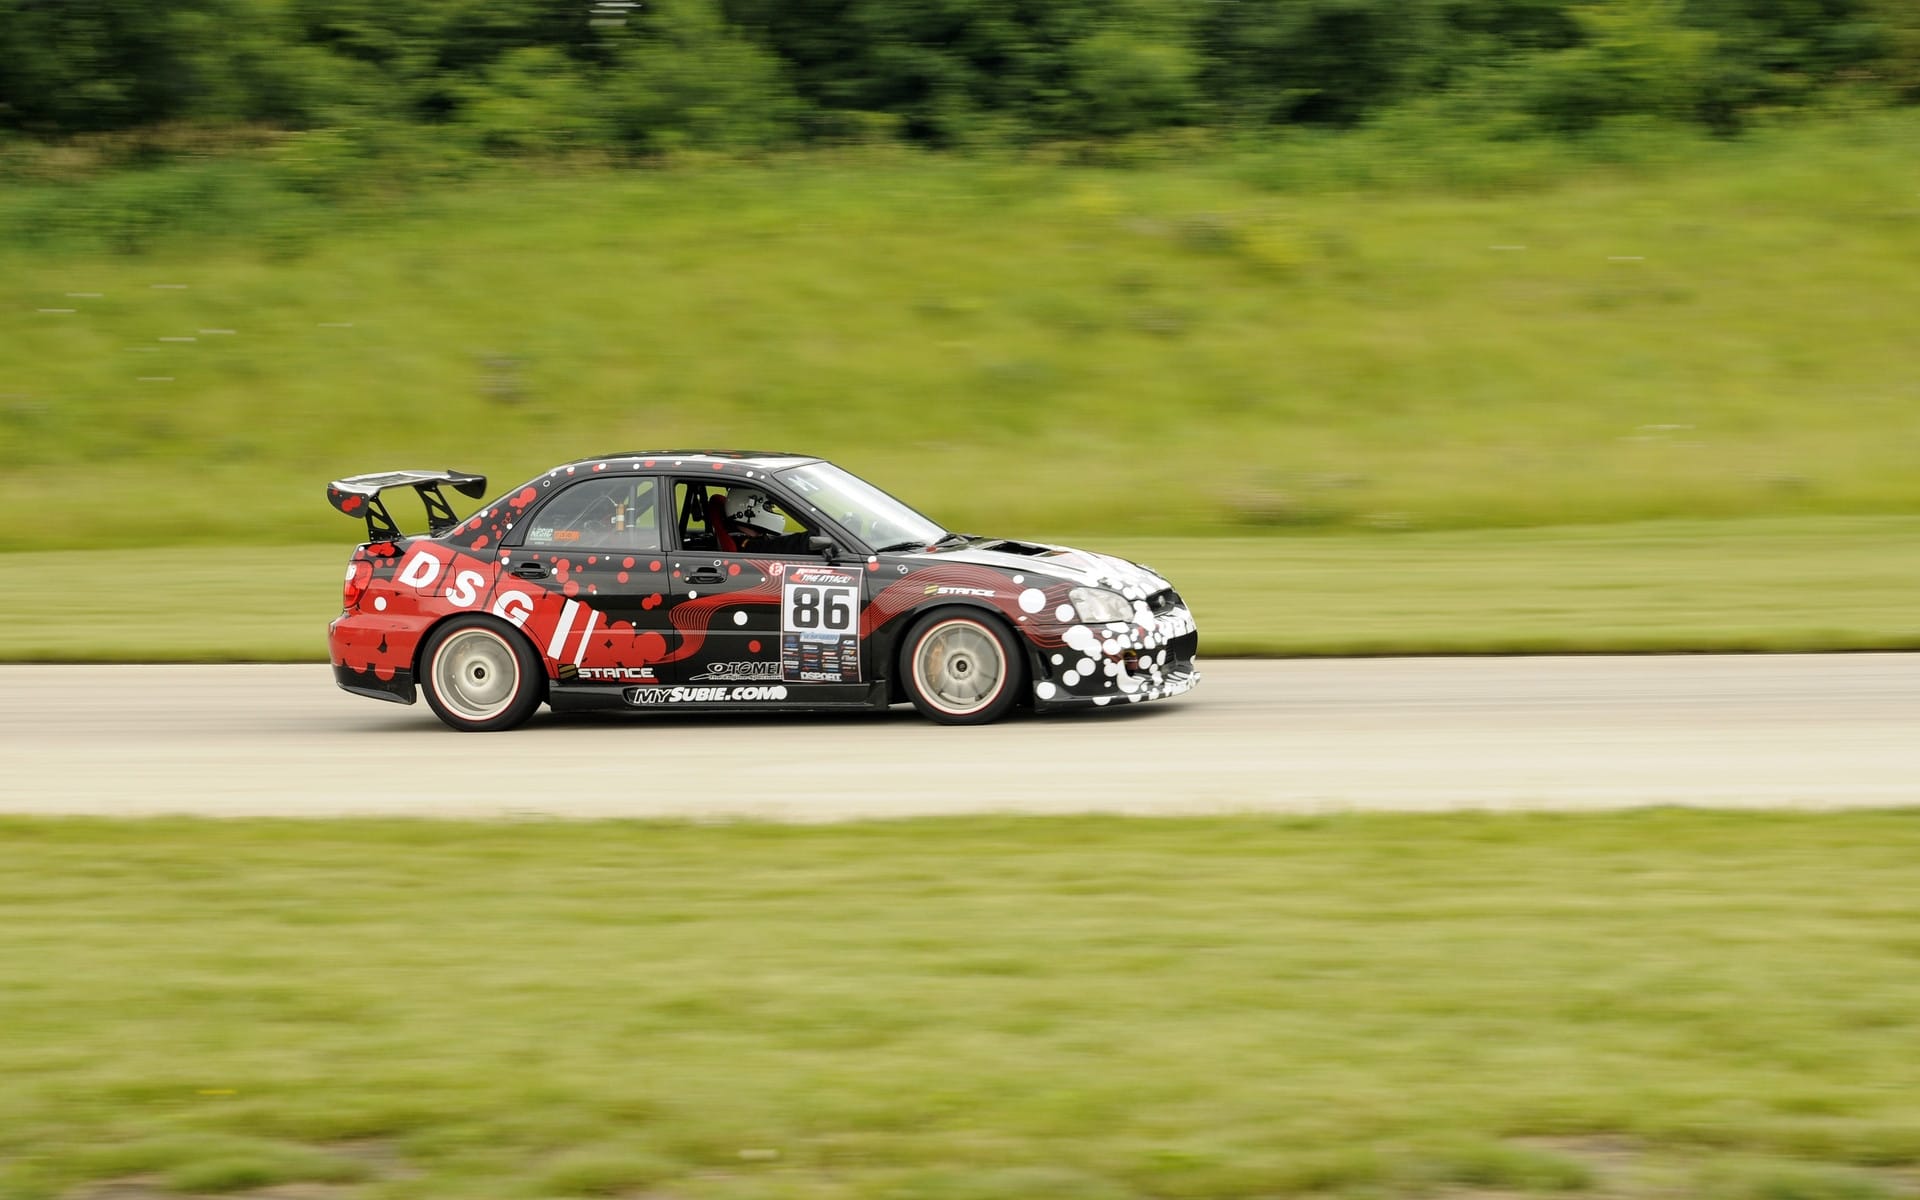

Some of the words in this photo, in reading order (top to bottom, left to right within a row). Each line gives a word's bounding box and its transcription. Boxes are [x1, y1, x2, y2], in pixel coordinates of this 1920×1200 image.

[398, 551, 533, 627] DSG
[937, 587, 995, 596] STANCE
[793, 587, 850, 630] 86
[577, 667, 654, 678] STANCE
[800, 672, 841, 681] DSPORT
